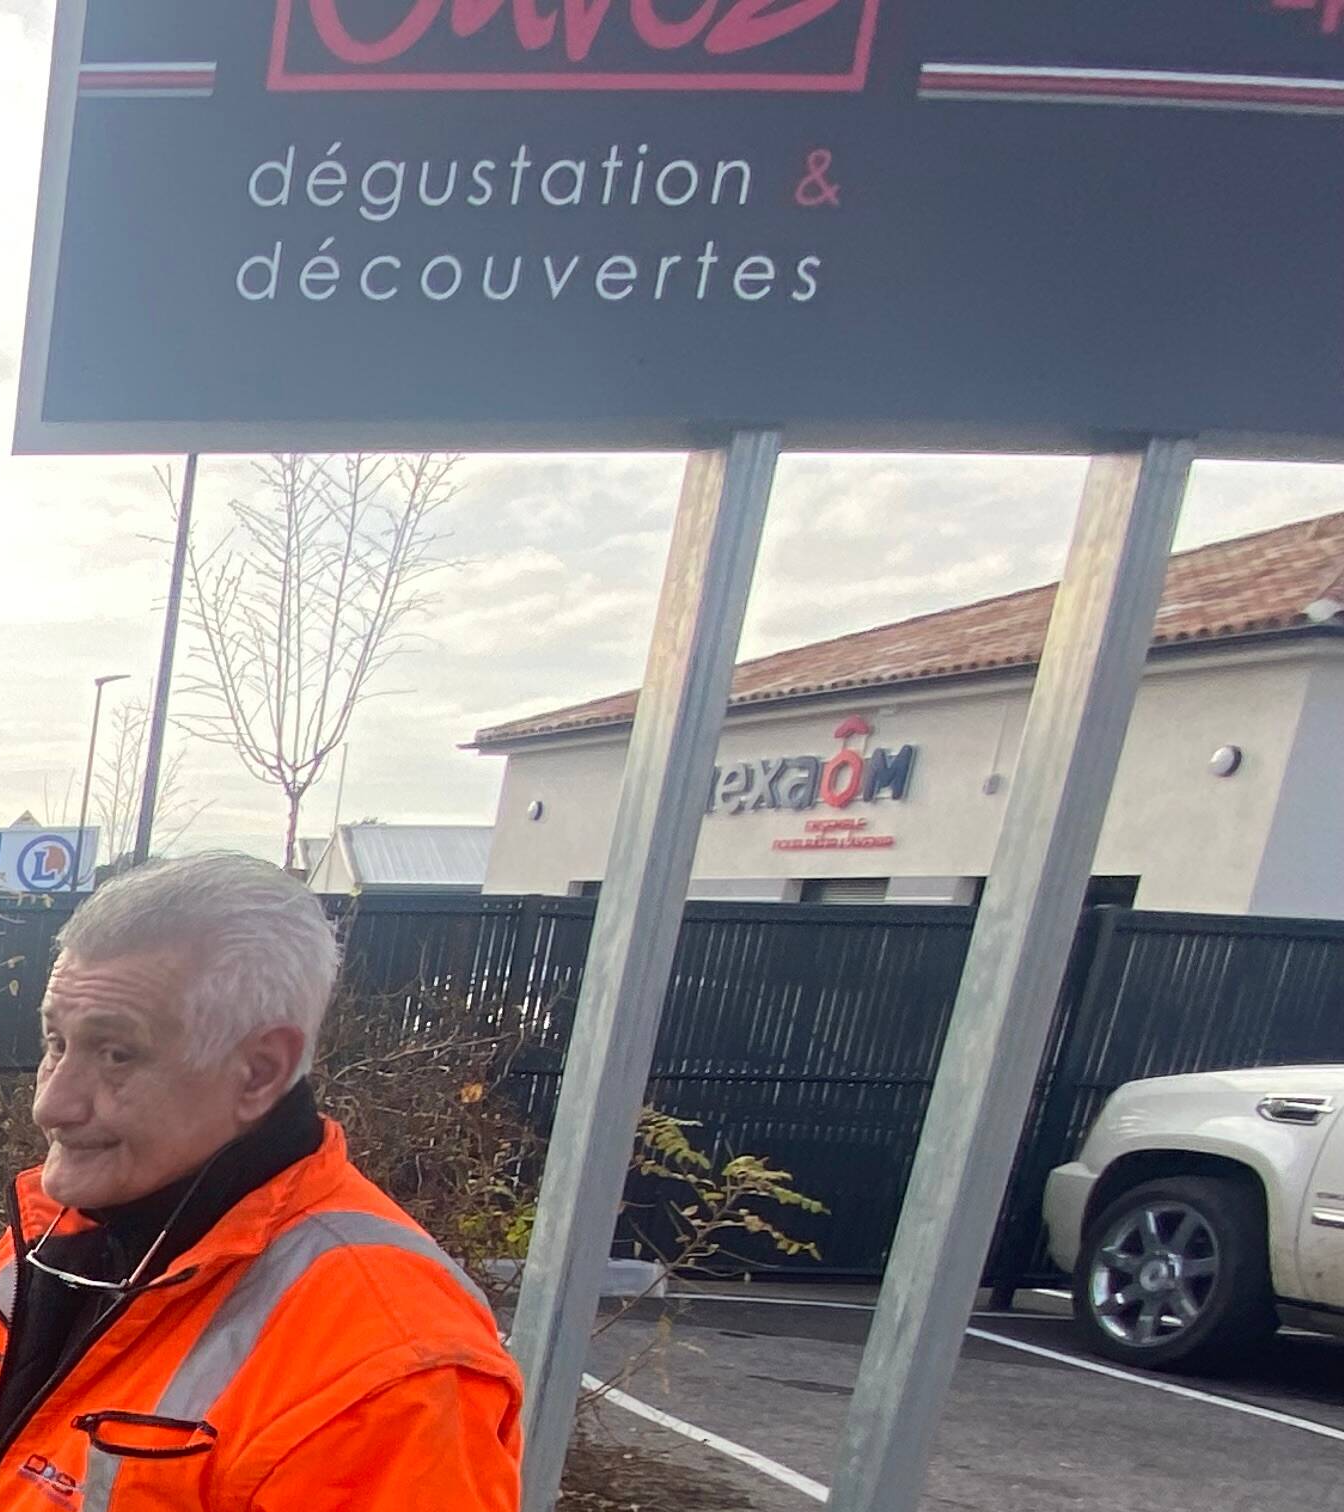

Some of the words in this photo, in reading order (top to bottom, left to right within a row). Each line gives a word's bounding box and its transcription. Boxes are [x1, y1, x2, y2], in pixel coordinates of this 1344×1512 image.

[247, 141, 752, 221] dégustation
[795, 150, 840, 205] &
[235, 236, 823, 302] découvertes
